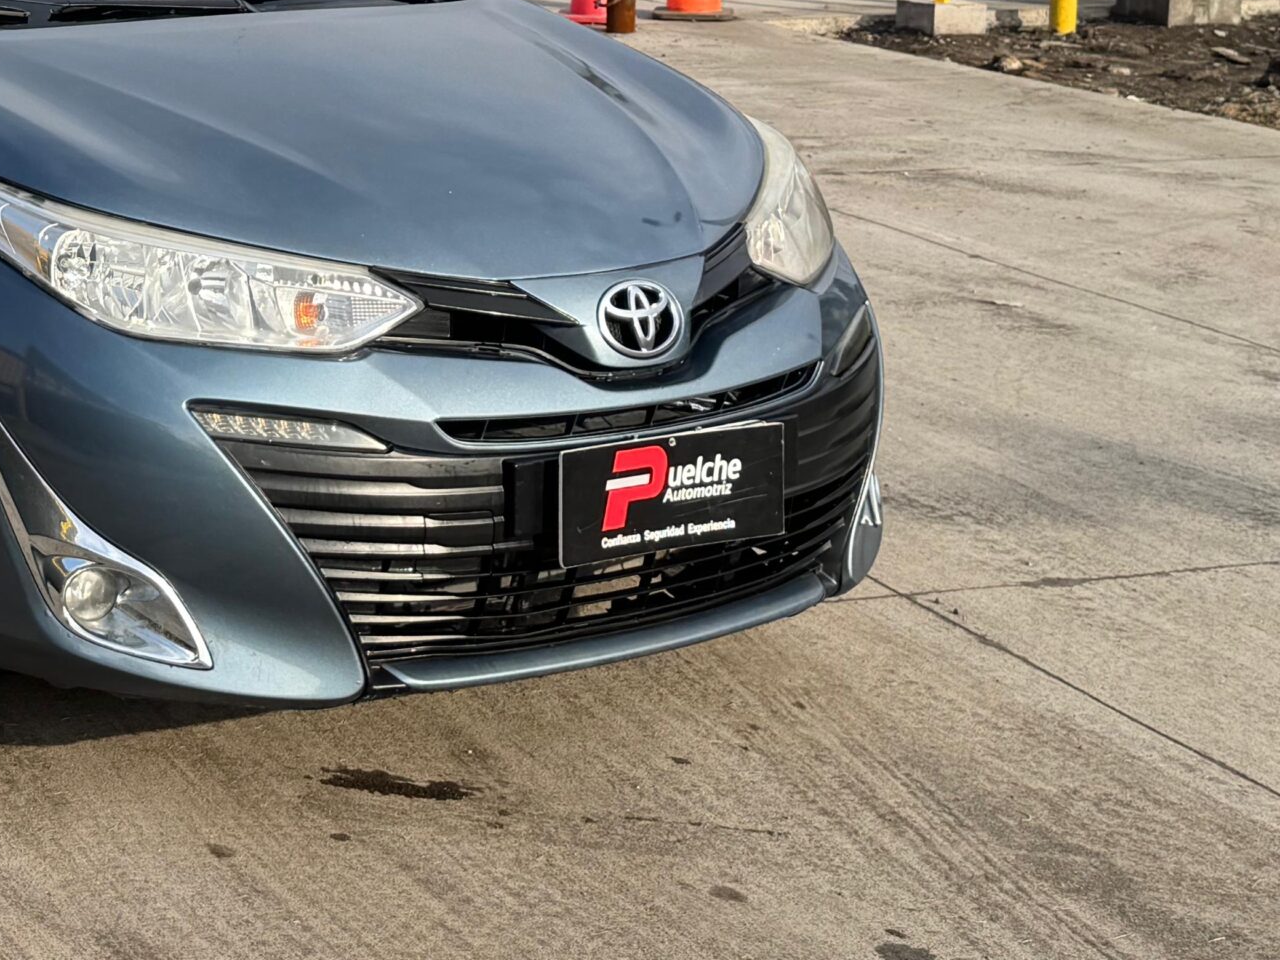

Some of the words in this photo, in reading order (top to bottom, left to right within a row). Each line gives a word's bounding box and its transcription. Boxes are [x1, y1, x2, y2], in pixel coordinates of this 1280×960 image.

[662, 480, 733, 503] Automotriz
[643, 524, 685, 541] Seguridad
[687, 518, 736, 535] Experiencia
